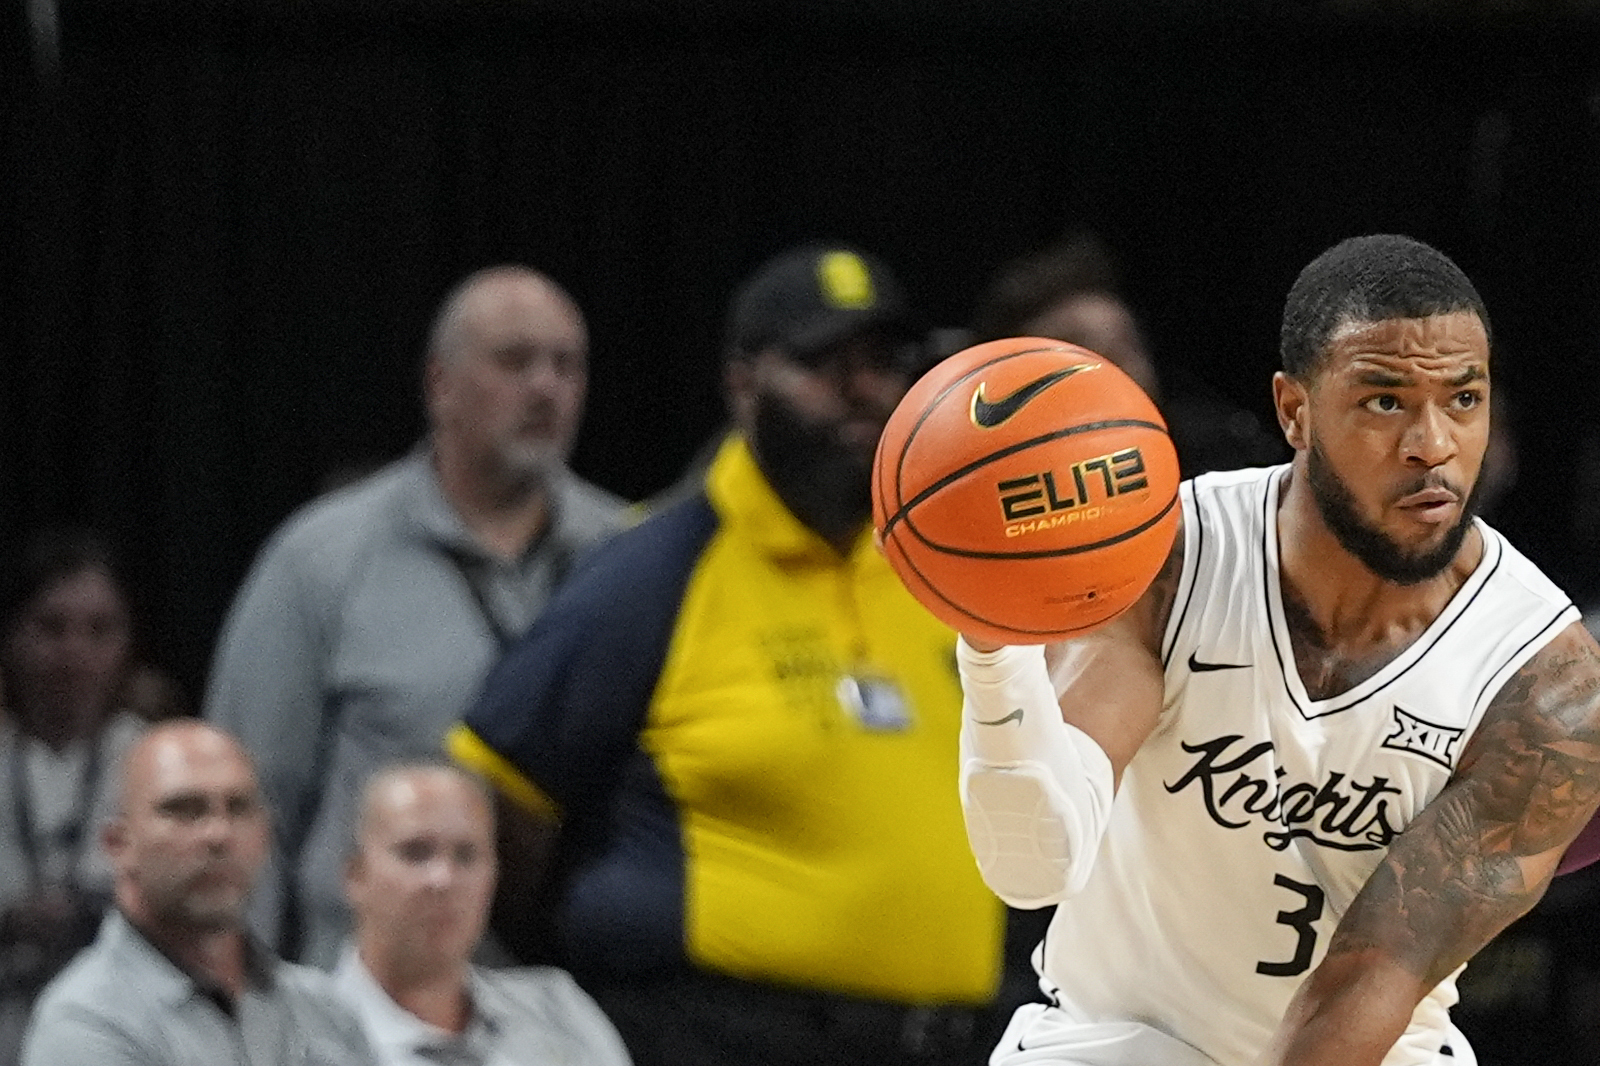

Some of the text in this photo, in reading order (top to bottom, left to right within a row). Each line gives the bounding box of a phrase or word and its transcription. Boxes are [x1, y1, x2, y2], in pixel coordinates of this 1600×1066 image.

[997, 446, 1149, 521] ELITE
[1163, 735, 1404, 851] Knights
[1256, 873, 1325, 977] 3
